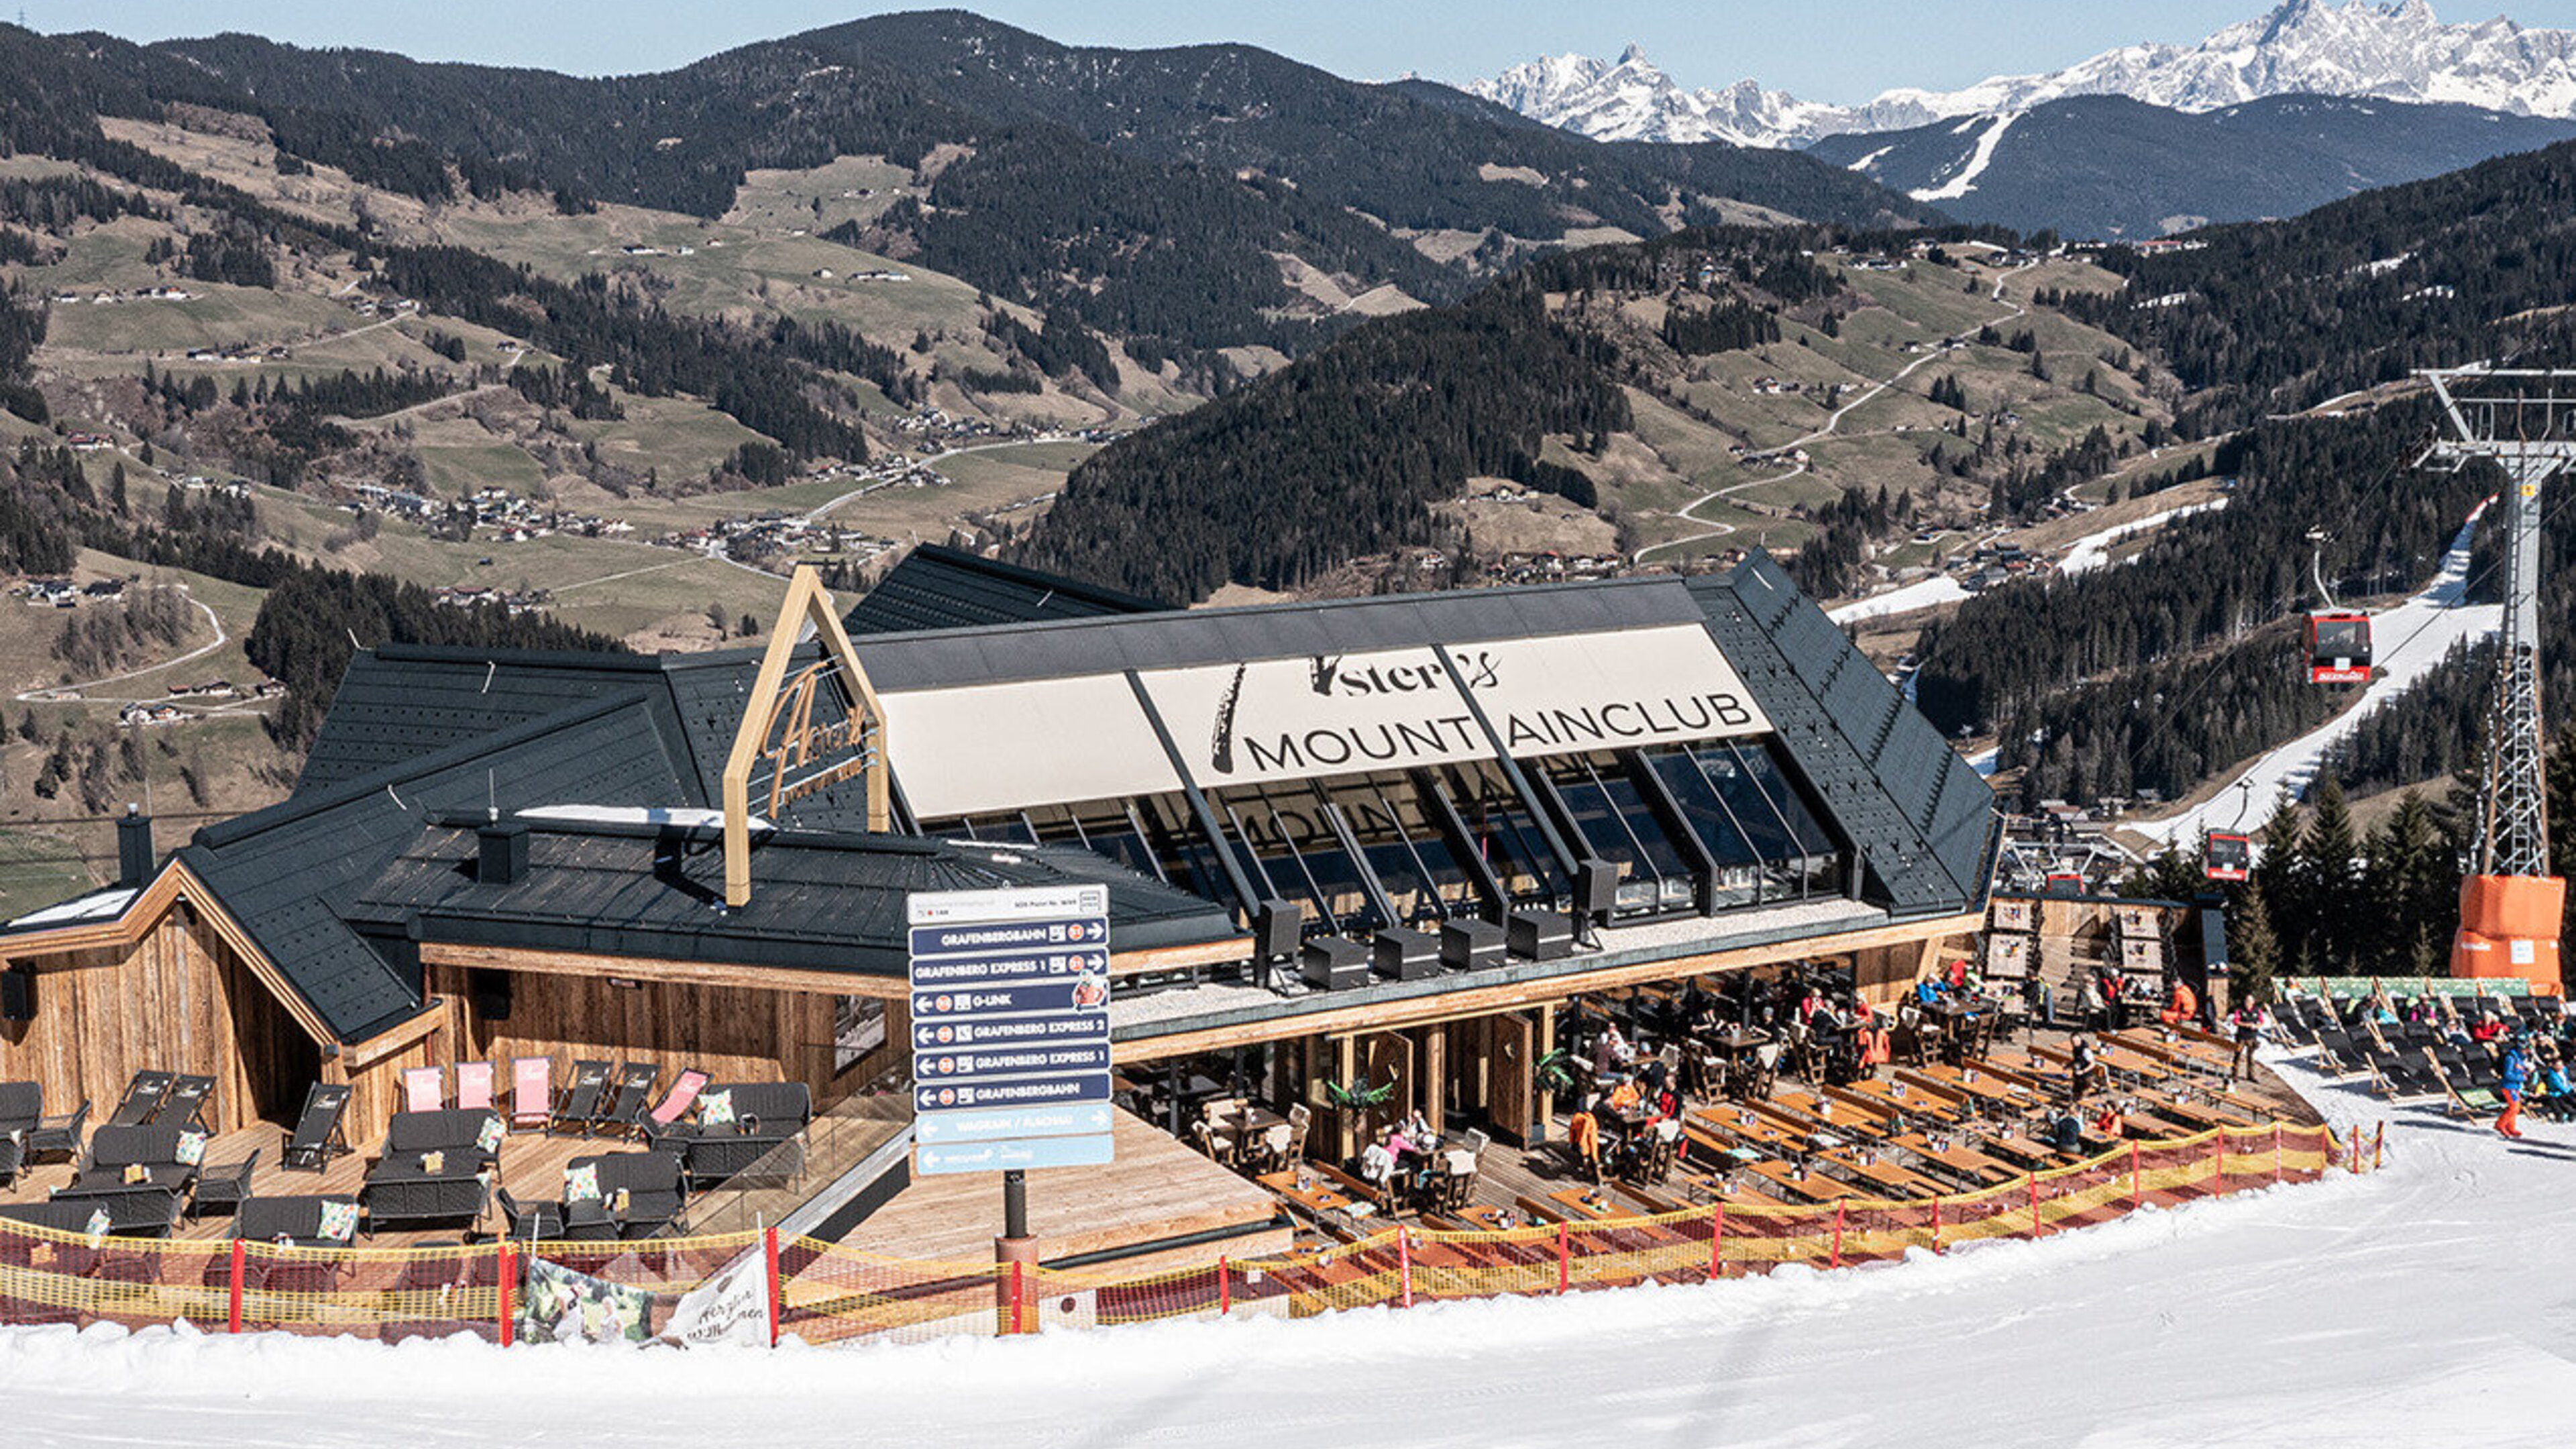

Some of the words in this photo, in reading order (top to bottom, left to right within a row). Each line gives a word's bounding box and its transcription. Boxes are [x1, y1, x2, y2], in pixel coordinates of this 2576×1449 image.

[942, 928, 1046, 946] GRAFENBERGBAHN
[916, 963, 988, 979] GRAFENBERG
[991, 961, 1037, 973] EXPRESS
[1040, 960, 1046, 971] 1
[974, 1022, 1046, 1038] GRAFENBERG
[1049, 1020, 1095, 1033] EXPRESS
[1097, 1020, 1105, 1030] 2
[976, 1054, 1048, 1069] GRAFENBERG
[1050, 1051, 1096, 1065] EXPRESS
[1098, 1051, 1104, 1061] 1
[976, 1083, 1081, 1100] GRAFENBERGBAHN
